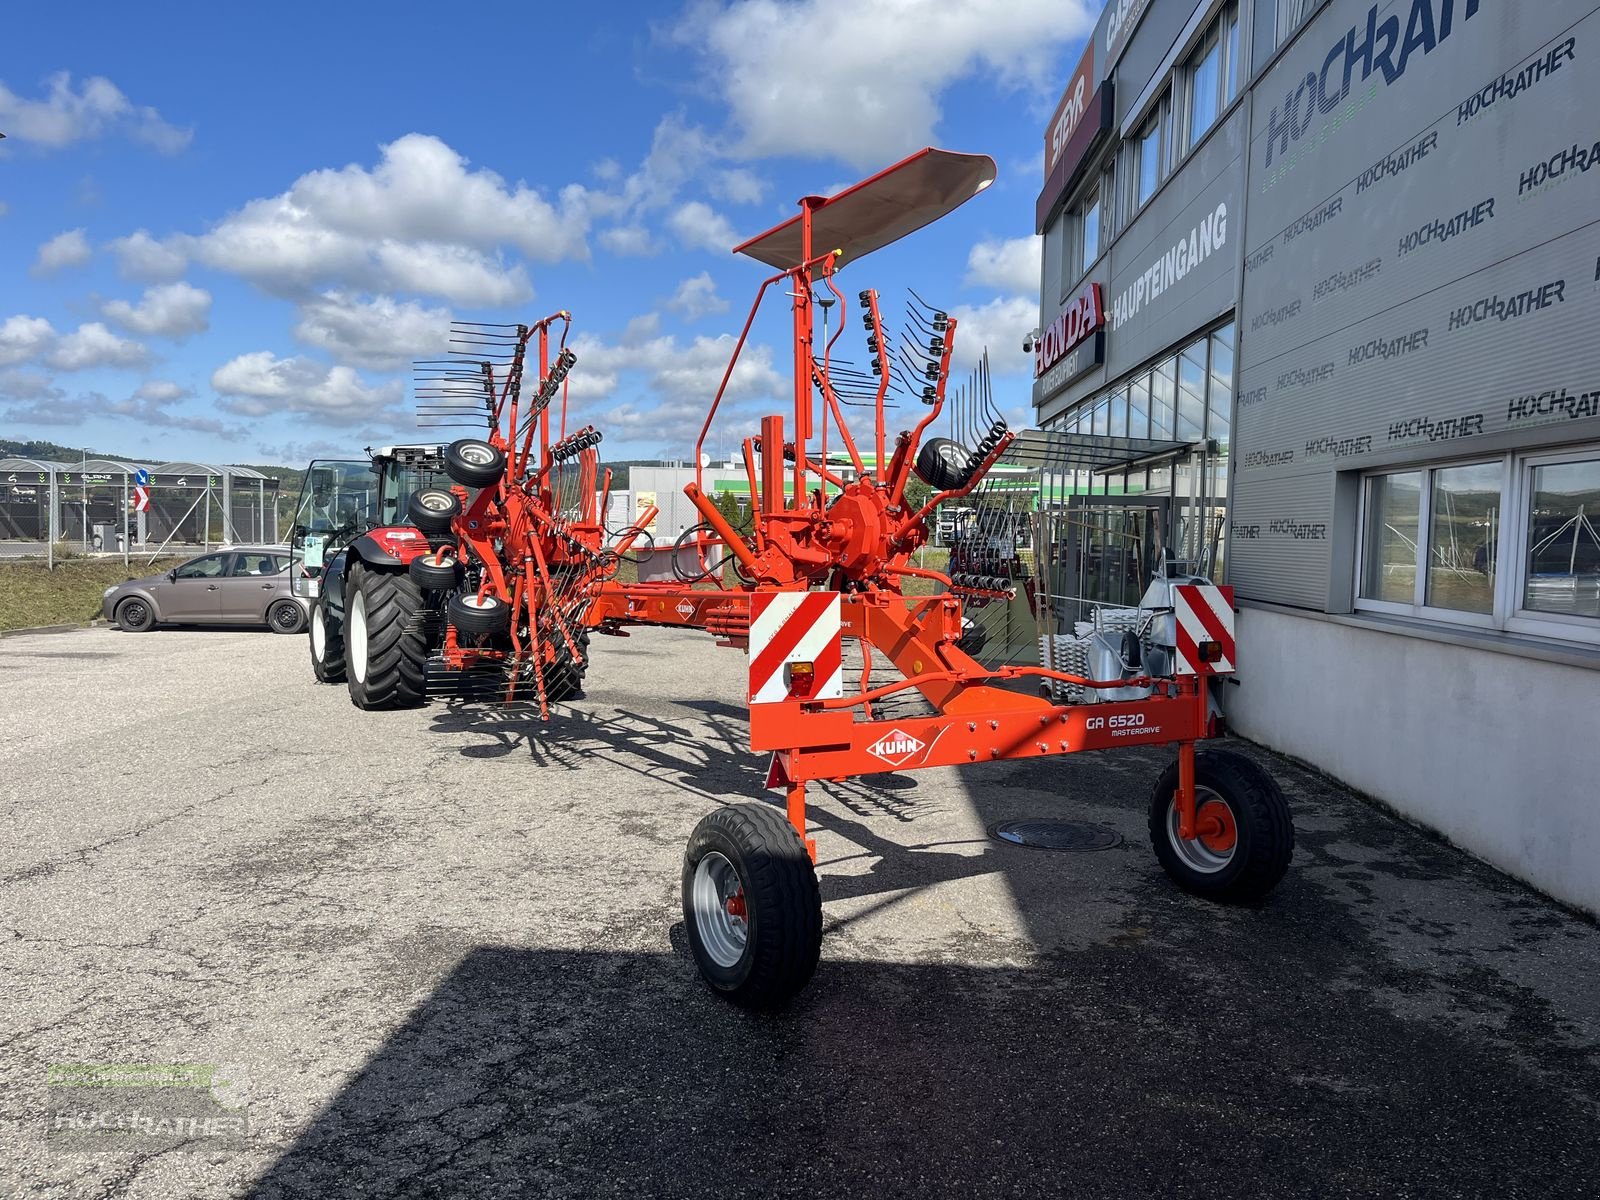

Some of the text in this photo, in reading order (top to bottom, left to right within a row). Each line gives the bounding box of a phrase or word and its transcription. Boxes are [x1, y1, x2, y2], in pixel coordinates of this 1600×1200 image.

[1457, 37, 1576, 127] HOCHRATHER
[1051, 74, 1085, 167] STEYR
[1356, 131, 1438, 194] HOCHRATHER
[1283, 197, 1342, 245] HOCHRATHER
[1397, 198, 1495, 257] HOCHRATHER
[1113, 203, 1227, 331] HAUPTEINGANG
[1312, 257, 1382, 301] HOCHRATHER
[1251, 299, 1302, 332] HOCHRATHER
[1447, 280, 1565, 331] HOCHRATHER
[1035, 284, 1100, 378] HONDA
[1347, 328, 1429, 366] HOCHRATHER
[1276, 362, 1335, 391] HOCHRATHER
[1304, 436, 1372, 457] HOCHRATHER
[1388, 413, 1484, 441] HOCHRATHER
[1269, 518, 1326, 539] HOCHRATHER
[1086, 714, 1145, 729] GA 6520
[1112, 726, 1160, 737] MASTERDRIVE
[875, 739, 917, 756] KUHN
